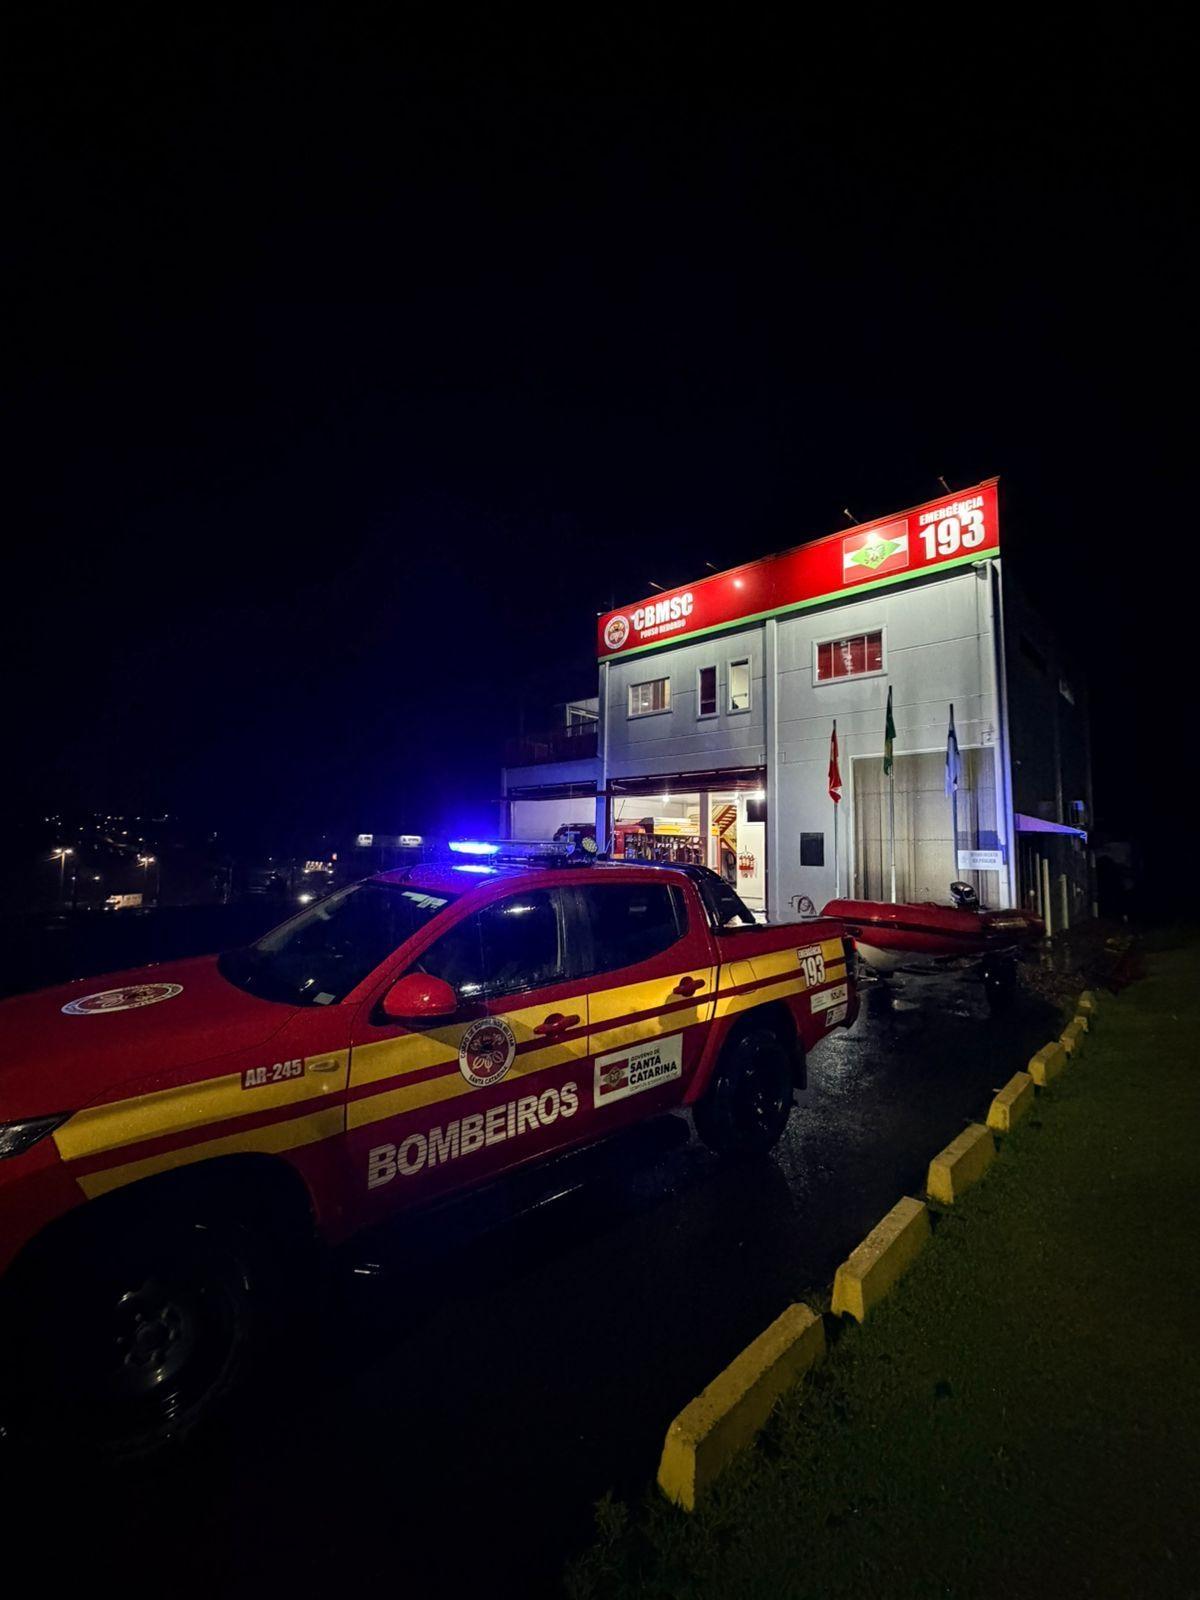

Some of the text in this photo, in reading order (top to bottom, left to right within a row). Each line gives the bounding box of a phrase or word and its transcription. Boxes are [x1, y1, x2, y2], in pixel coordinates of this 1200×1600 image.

[919, 496, 984, 526] EMERGÊNCIA
[919, 509, 985, 560] 193
[633, 592, 693, 630] CBMSC
[801, 955, 825, 987] 193
[244, 1058, 302, 1087] AR-245
[629, 1061, 677, 1085] CATARINA
[630, 1055, 661, 1073] SANTA
[367, 1080, 580, 1190] BOMBEIROS
